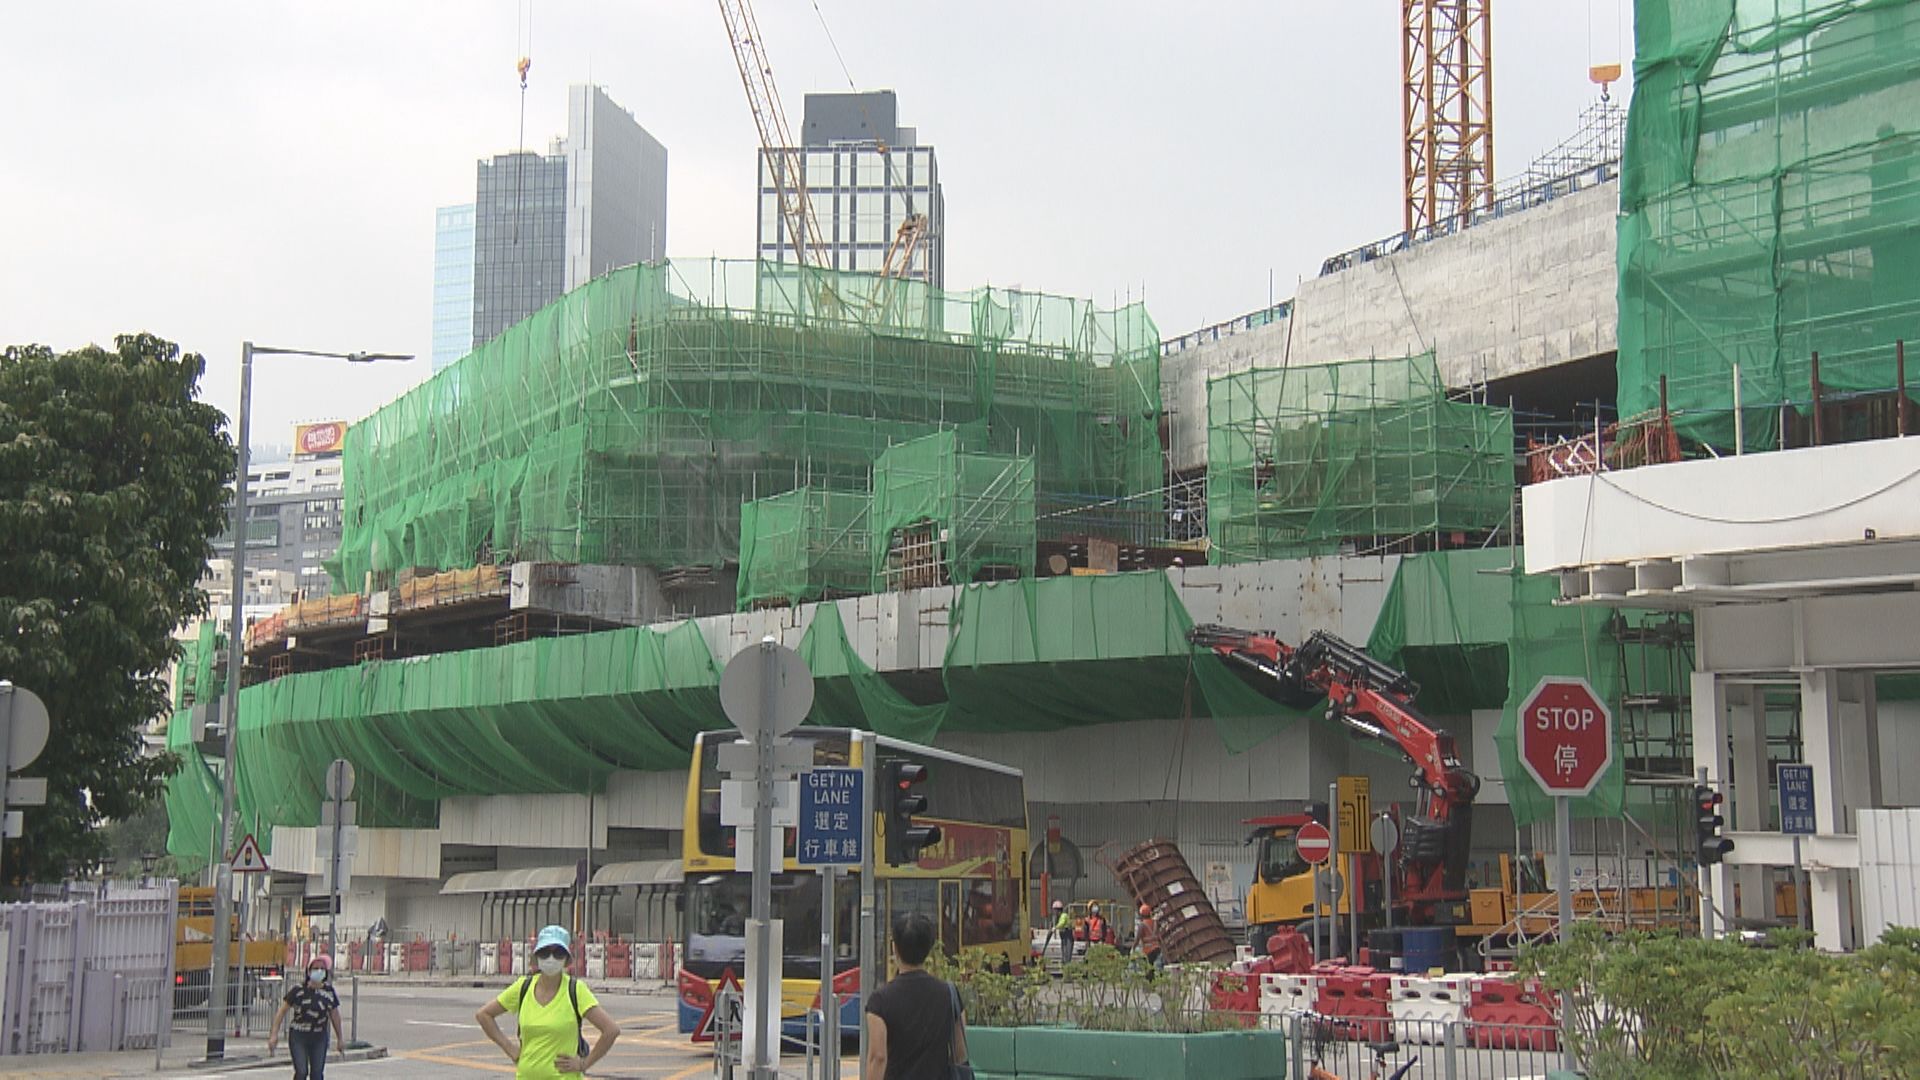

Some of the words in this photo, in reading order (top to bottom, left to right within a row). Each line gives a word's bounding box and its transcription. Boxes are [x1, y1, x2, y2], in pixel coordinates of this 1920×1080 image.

[1536, 706, 1594, 731] STOP
[1553, 743, 1578, 775] 停
[808, 773, 836, 787] GET
[839, 773, 855, 788] IN
[1782, 768, 1798, 780] GET
[1800, 768, 1809, 780] IN
[1786, 781, 1808, 792] LANE
[814, 789, 850, 804] LANE
[814, 810, 849, 831] 選定
